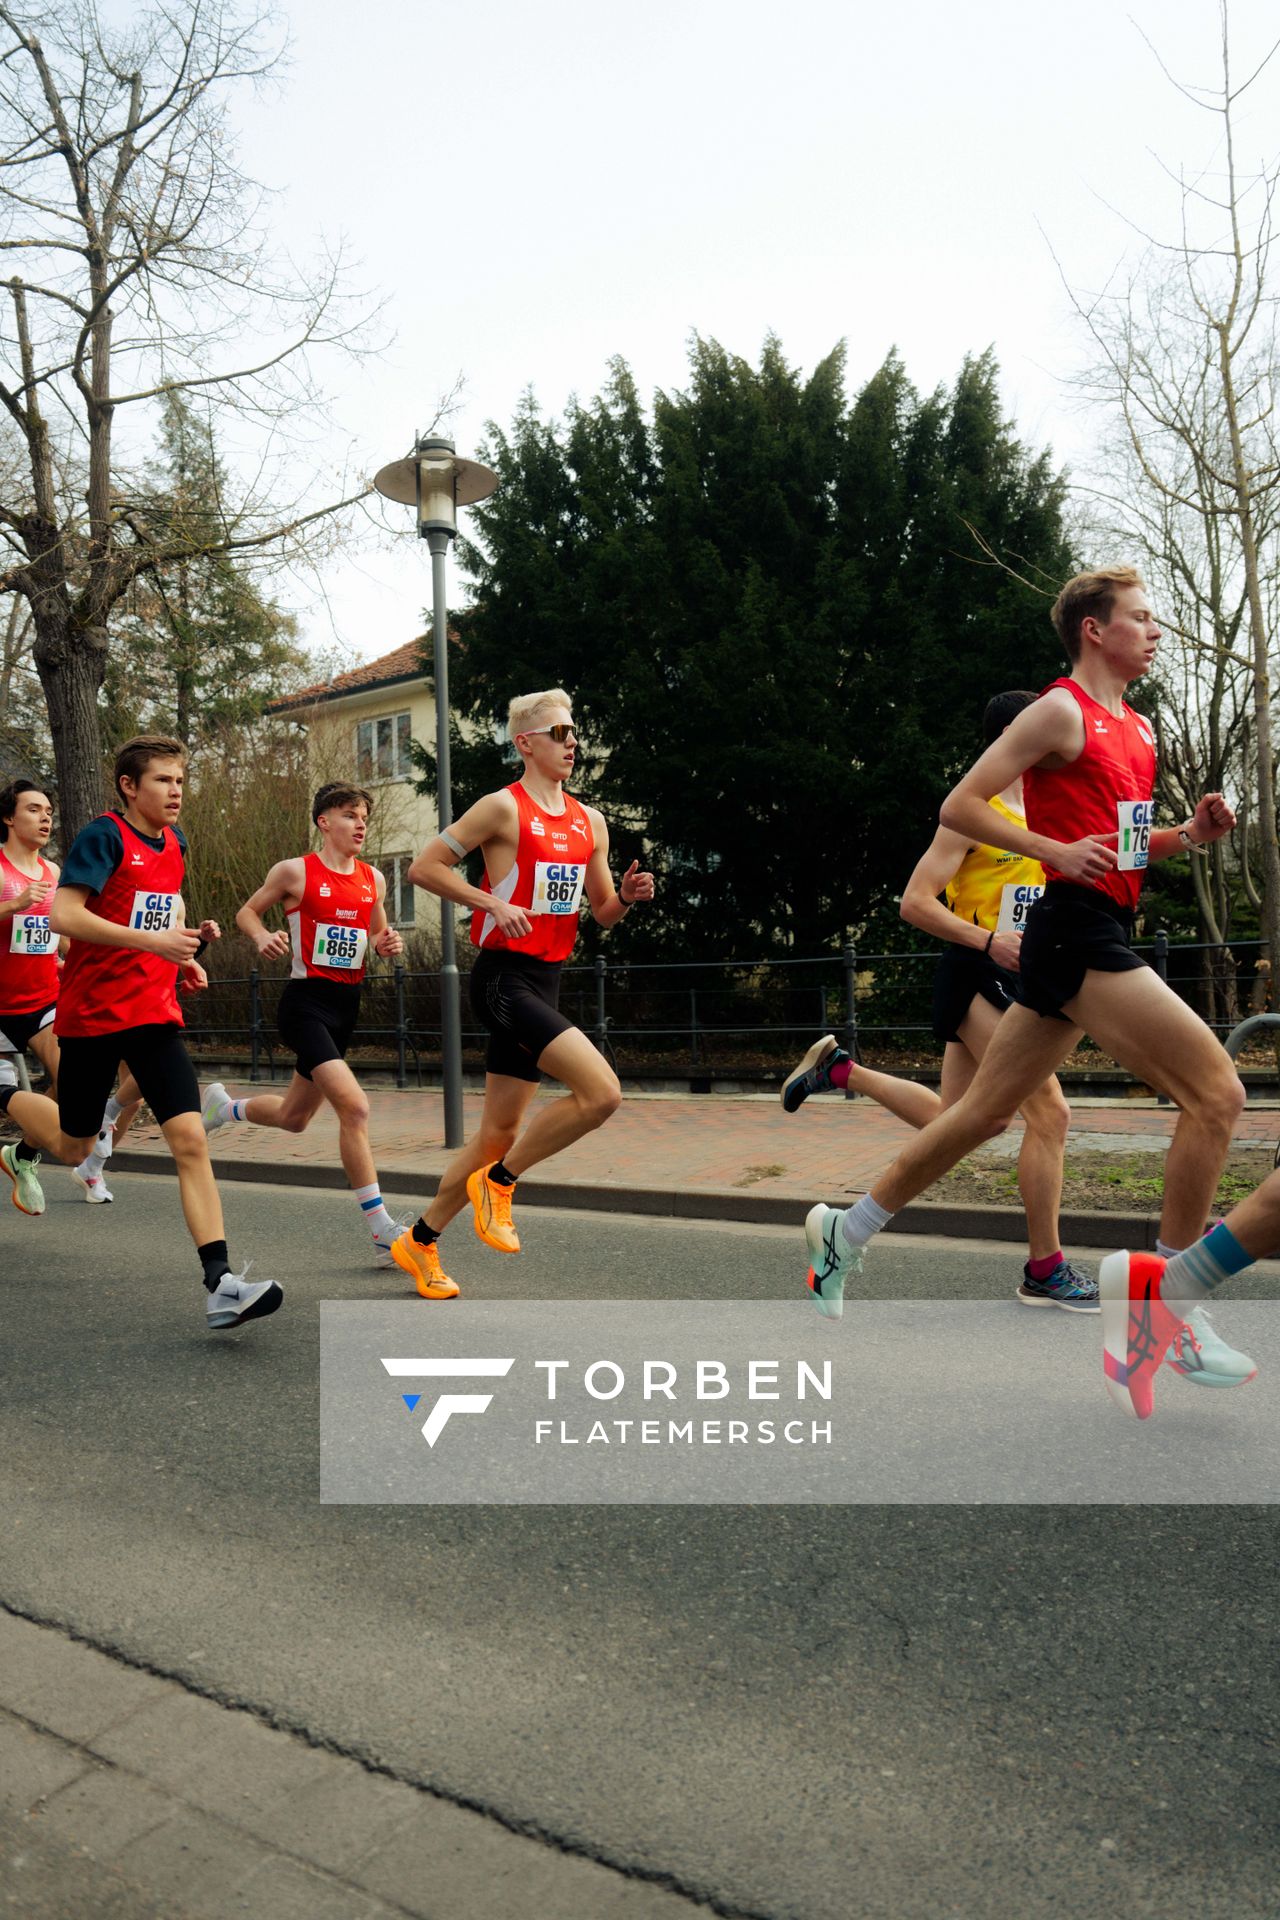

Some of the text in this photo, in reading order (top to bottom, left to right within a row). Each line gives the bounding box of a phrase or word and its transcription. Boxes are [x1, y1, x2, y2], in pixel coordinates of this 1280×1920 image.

[1133, 825, 1151, 852] 76
[546, 864, 579, 882] GLS
[546, 881, 578, 902] 867
[145, 894, 173, 912] GLS
[23, 916, 50, 929] GLS
[143, 911, 171, 931] 954
[24, 929, 51, 944] 130
[326, 926, 358, 942] GLS
[326, 939, 357, 959] 865
